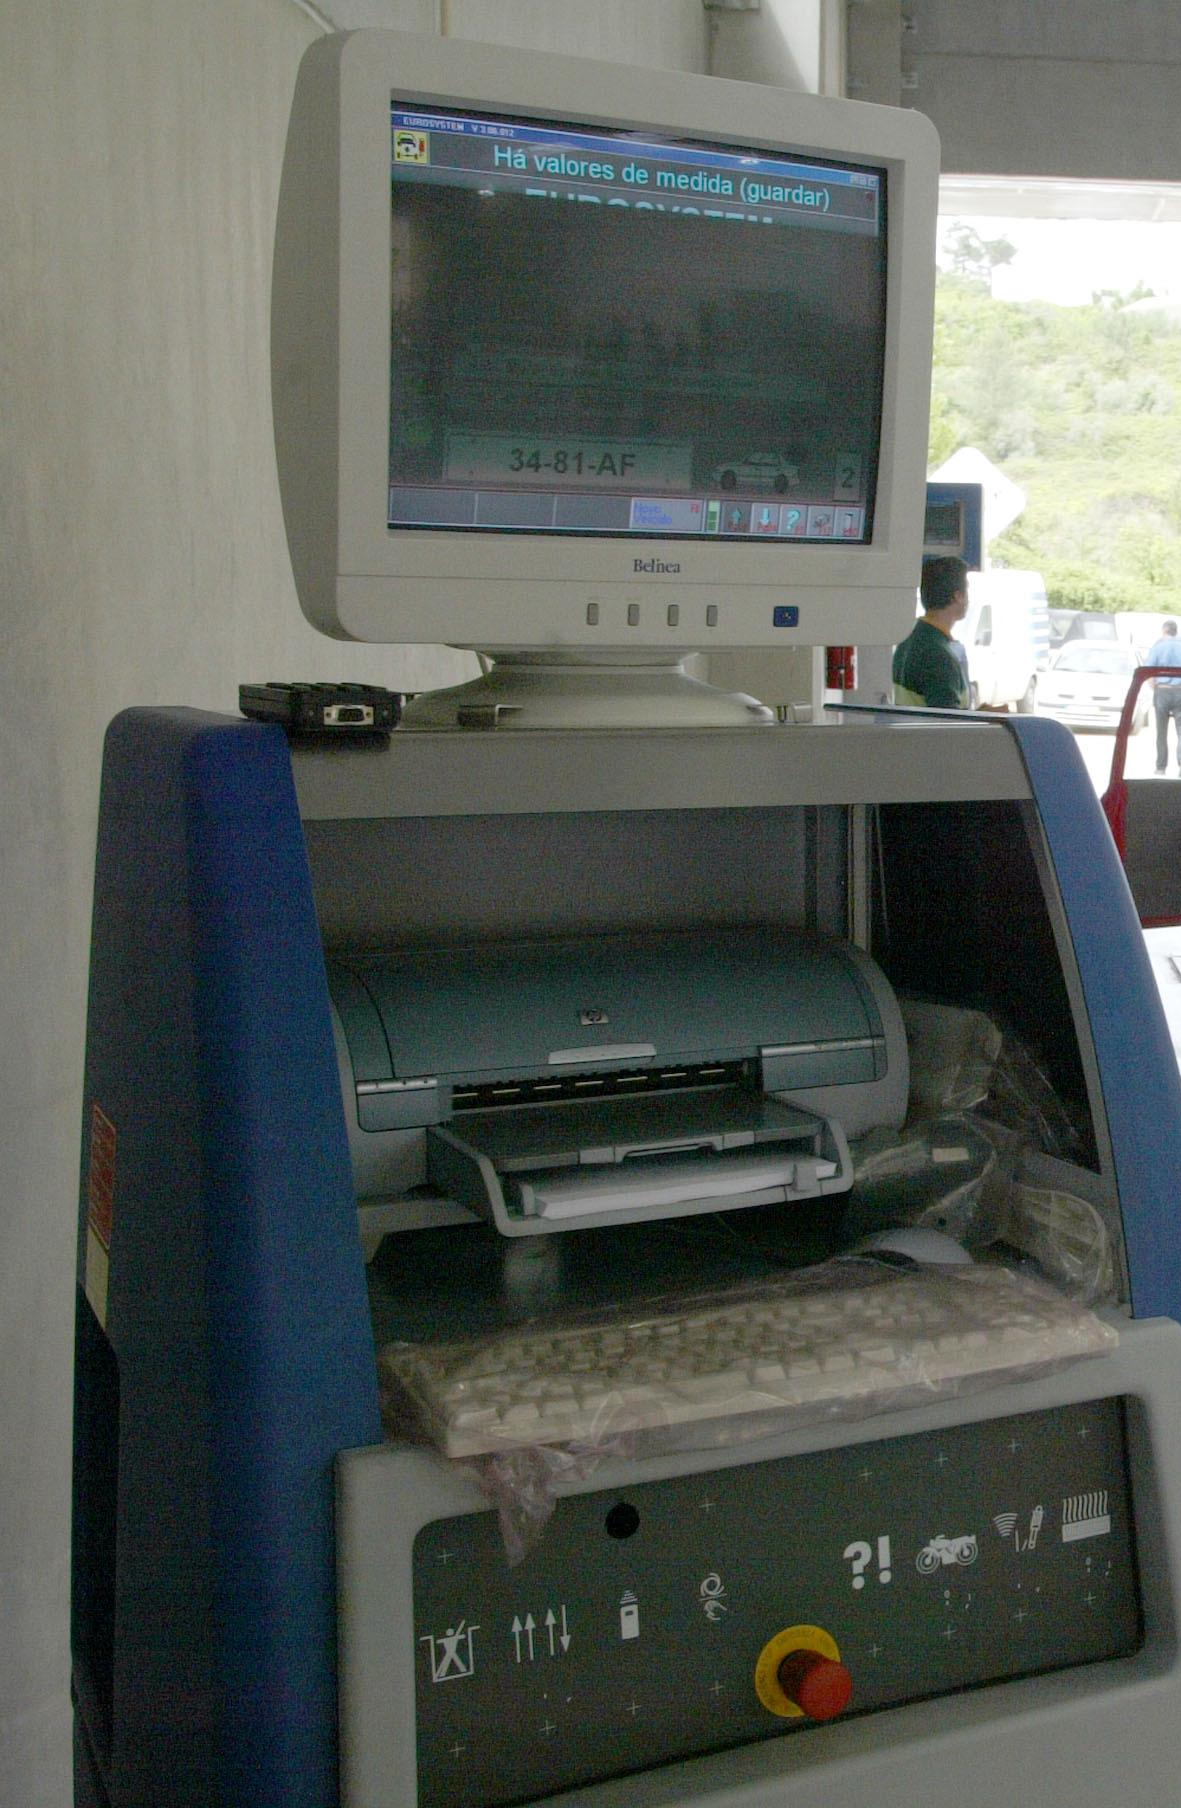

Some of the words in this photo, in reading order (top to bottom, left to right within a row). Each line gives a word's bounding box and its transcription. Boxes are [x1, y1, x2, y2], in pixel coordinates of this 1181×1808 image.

[494, 145, 527, 169] Há
[533, 153, 615, 181] valores
[622, 162, 649, 185] de
[656, 170, 733, 196] medida
[740, 177, 831, 212] (guardar)
[509, 448, 636, 477] 34-81-AF
[842, 467, 854, 489] 2
[633, 558, 681, 573] Belinea
